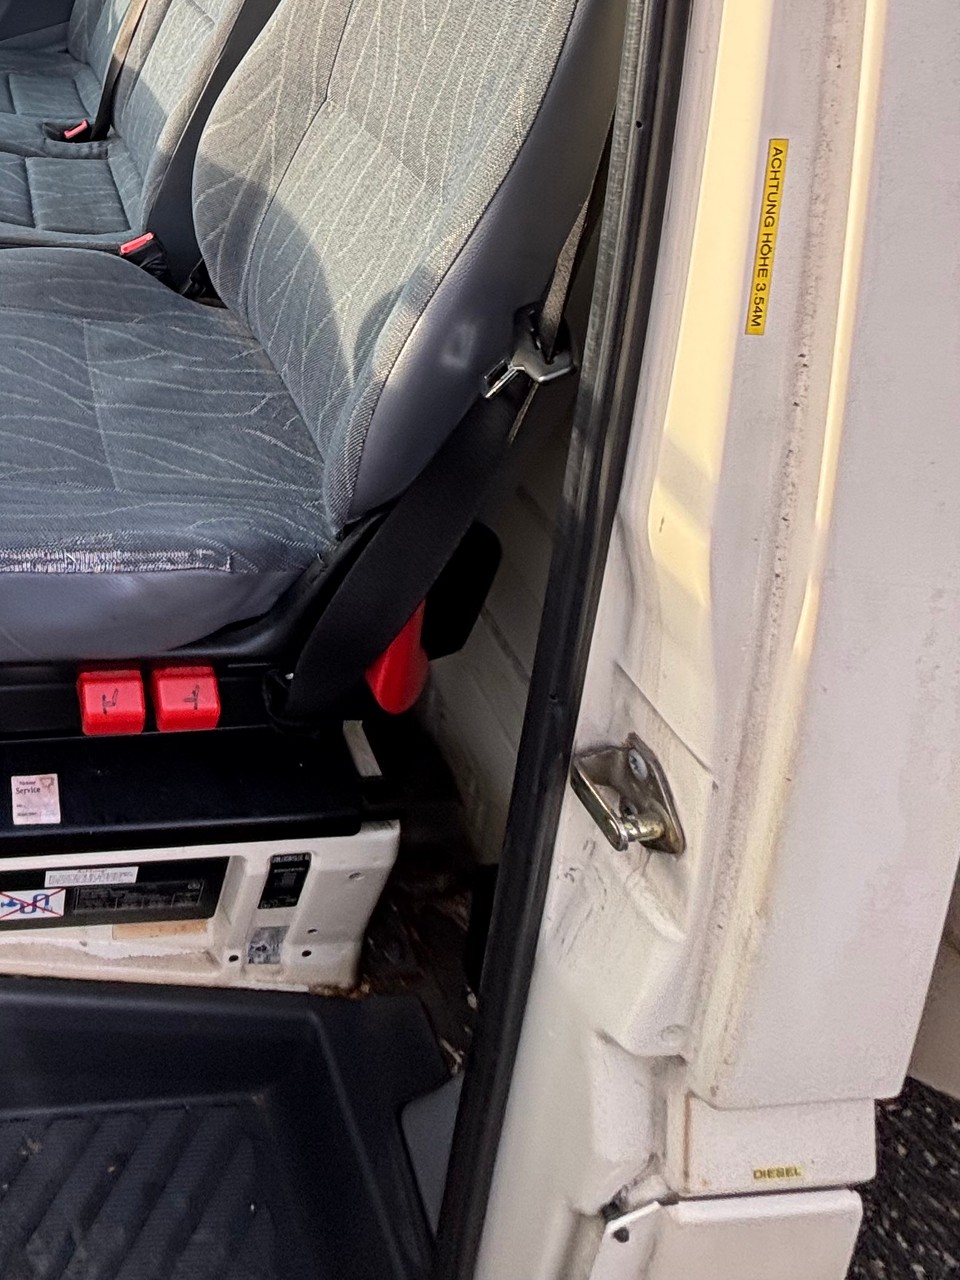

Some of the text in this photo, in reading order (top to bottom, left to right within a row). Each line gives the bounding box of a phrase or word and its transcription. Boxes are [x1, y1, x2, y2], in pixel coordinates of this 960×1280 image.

[751, 146, 784, 327] ACHTUNG HÖHE 3.54M
[16, 787, 40, 795] Service
[753, 1166, 801, 1179] DIESEL
